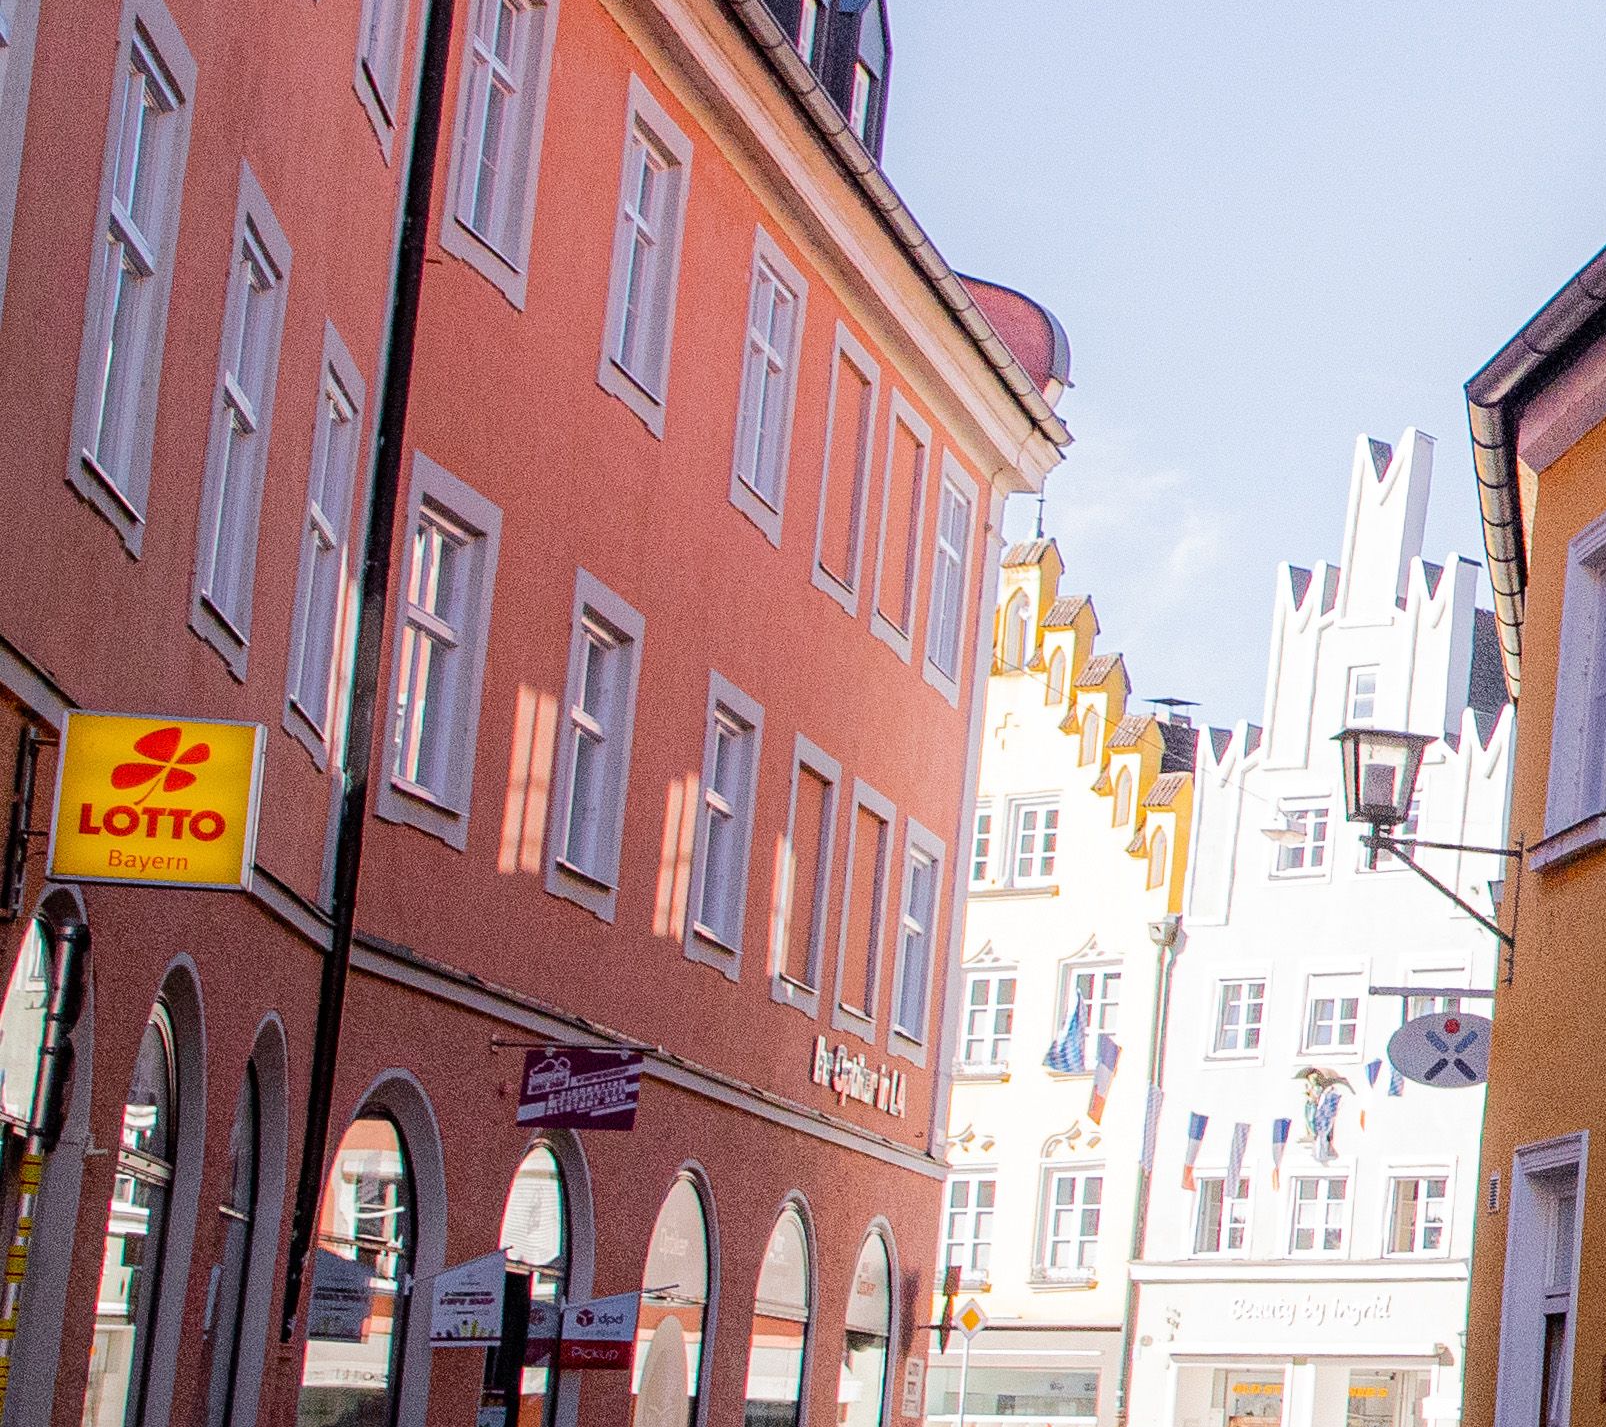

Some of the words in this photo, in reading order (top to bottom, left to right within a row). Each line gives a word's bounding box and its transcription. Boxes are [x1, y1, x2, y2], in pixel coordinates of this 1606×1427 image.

[79, 803, 226, 842] LOTTO
[108, 849, 188, 873] Bayern
[597, 1313, 624, 1326] dpd
